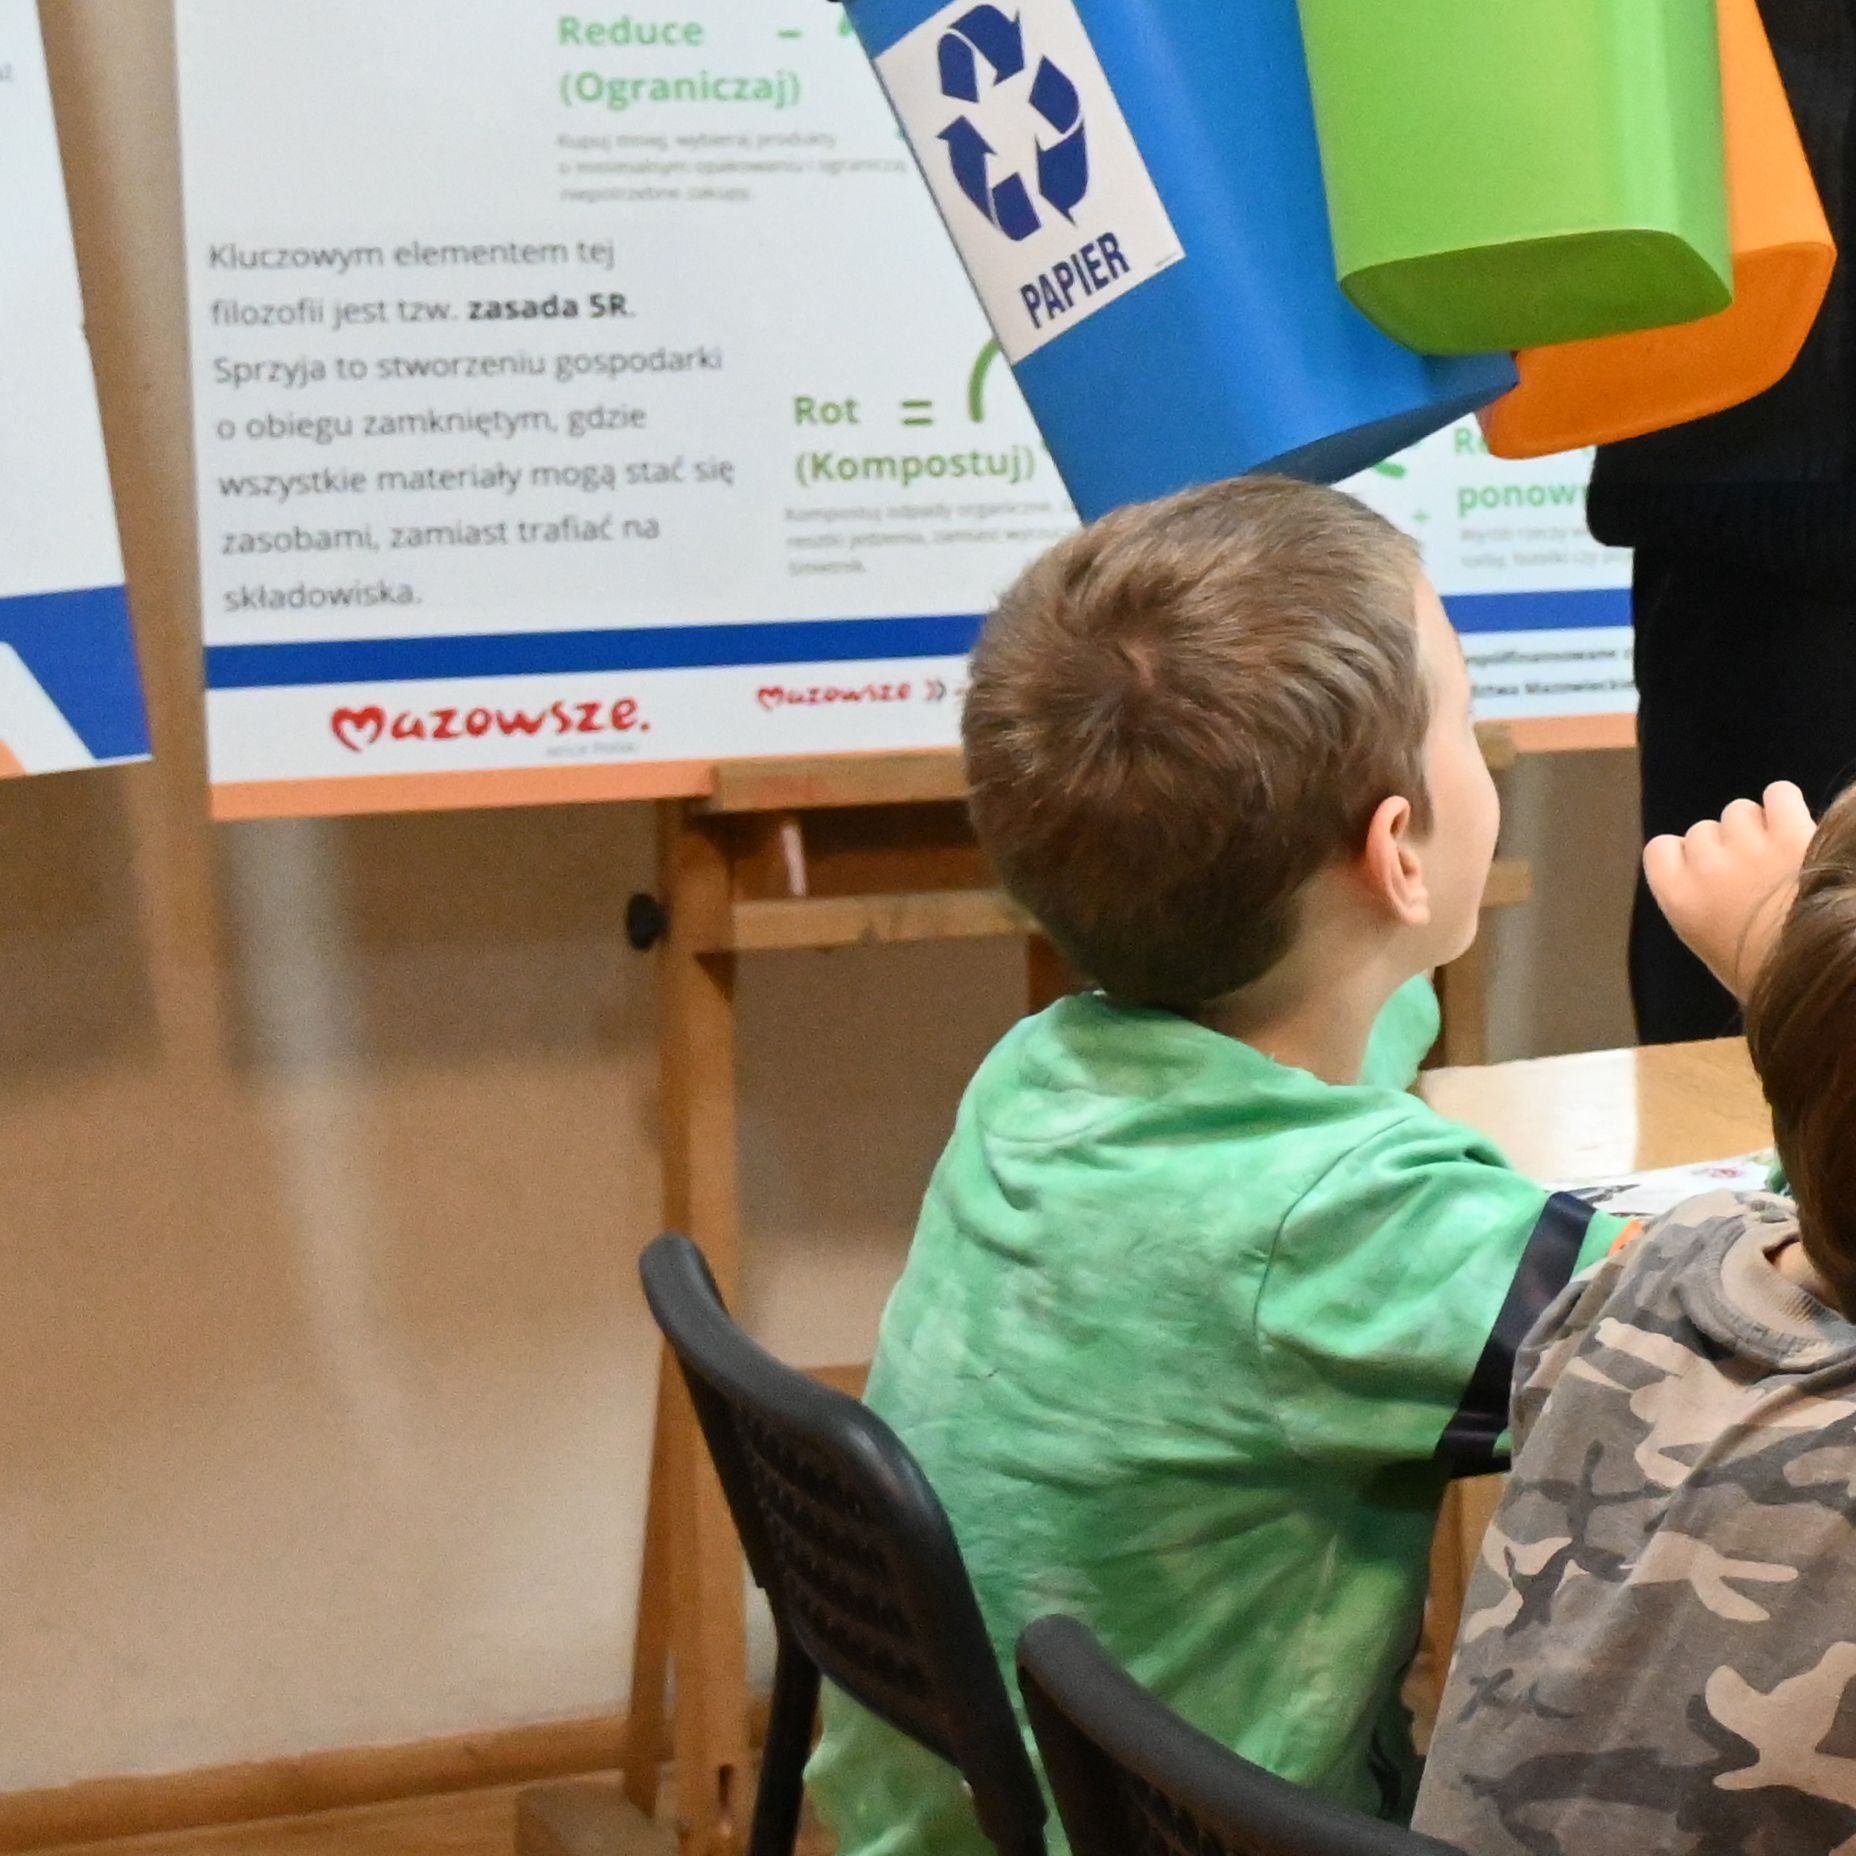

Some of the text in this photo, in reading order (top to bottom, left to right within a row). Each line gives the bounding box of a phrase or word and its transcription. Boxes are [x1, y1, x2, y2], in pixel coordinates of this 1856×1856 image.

[558, 17, 702, 46] Reduce
[559, 70, 801, 110] (Ograniczaj)
[208, 239, 616, 273] Kluczowym elementem tej
[1018, 232, 1130, 329] PAPIER
[211, 295, 325, 326] filozofii
[332, 297, 387, 326] jest
[397, 297, 458, 324] tzw.
[468, 293, 579, 321] zasada
[214, 346, 723, 387] Sprzyja to stworzeniu gospodarki
[217, 404, 647, 442] o obiegu zamkniętym, gdzie
[794, 396, 859, 425] Rot
[218, 456, 735, 502] wszystkie materiały mogą stać się
[795, 445, 1037, 486] (Kompostuj)
[222, 515, 660, 556] zasobami, zamiast trafiać na
[224, 579, 423, 610] składowiska.
